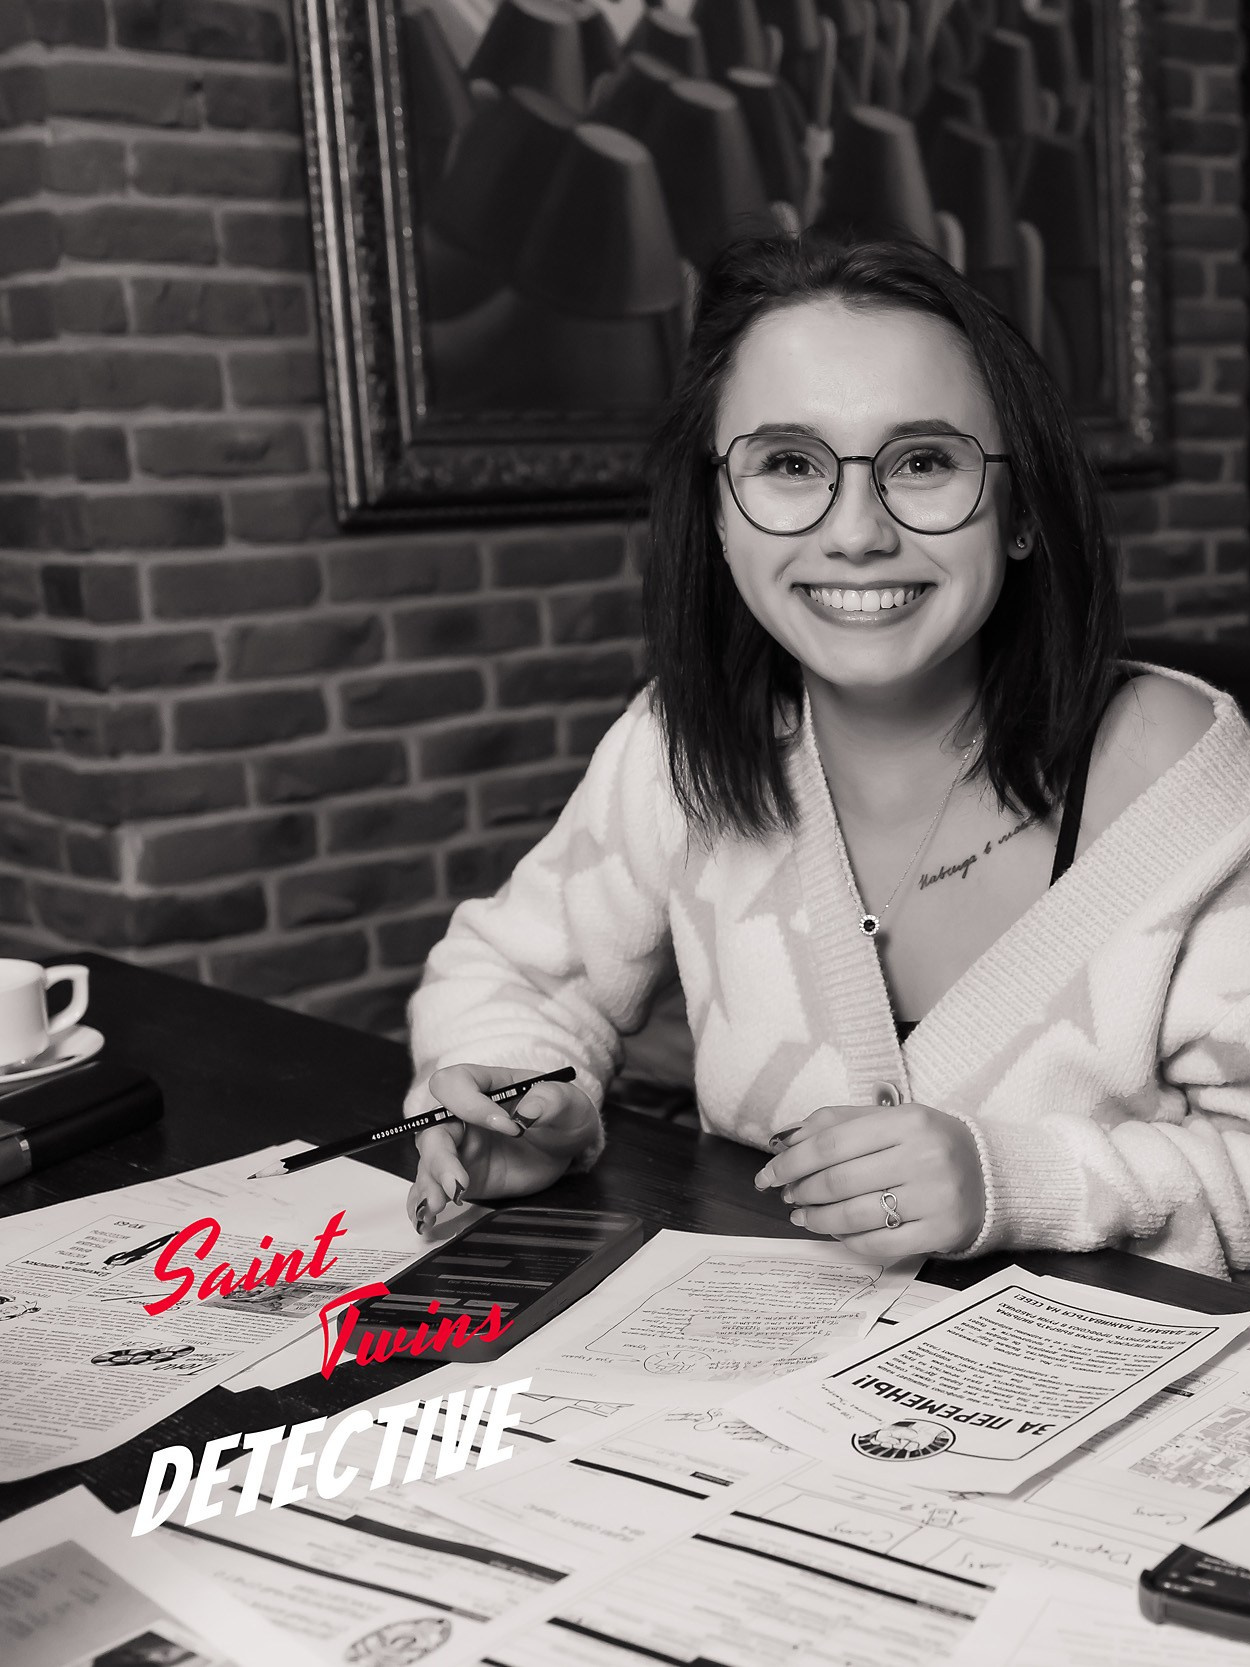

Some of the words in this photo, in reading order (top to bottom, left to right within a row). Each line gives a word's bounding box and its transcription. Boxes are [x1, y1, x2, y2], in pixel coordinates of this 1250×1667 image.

[371, 1116, 430, 1141] 4630082114829
[851, 1374, 1014, 1430] ПЕРЕМЕНЫ!
[1017, 1422, 1056, 1436] ЗА
